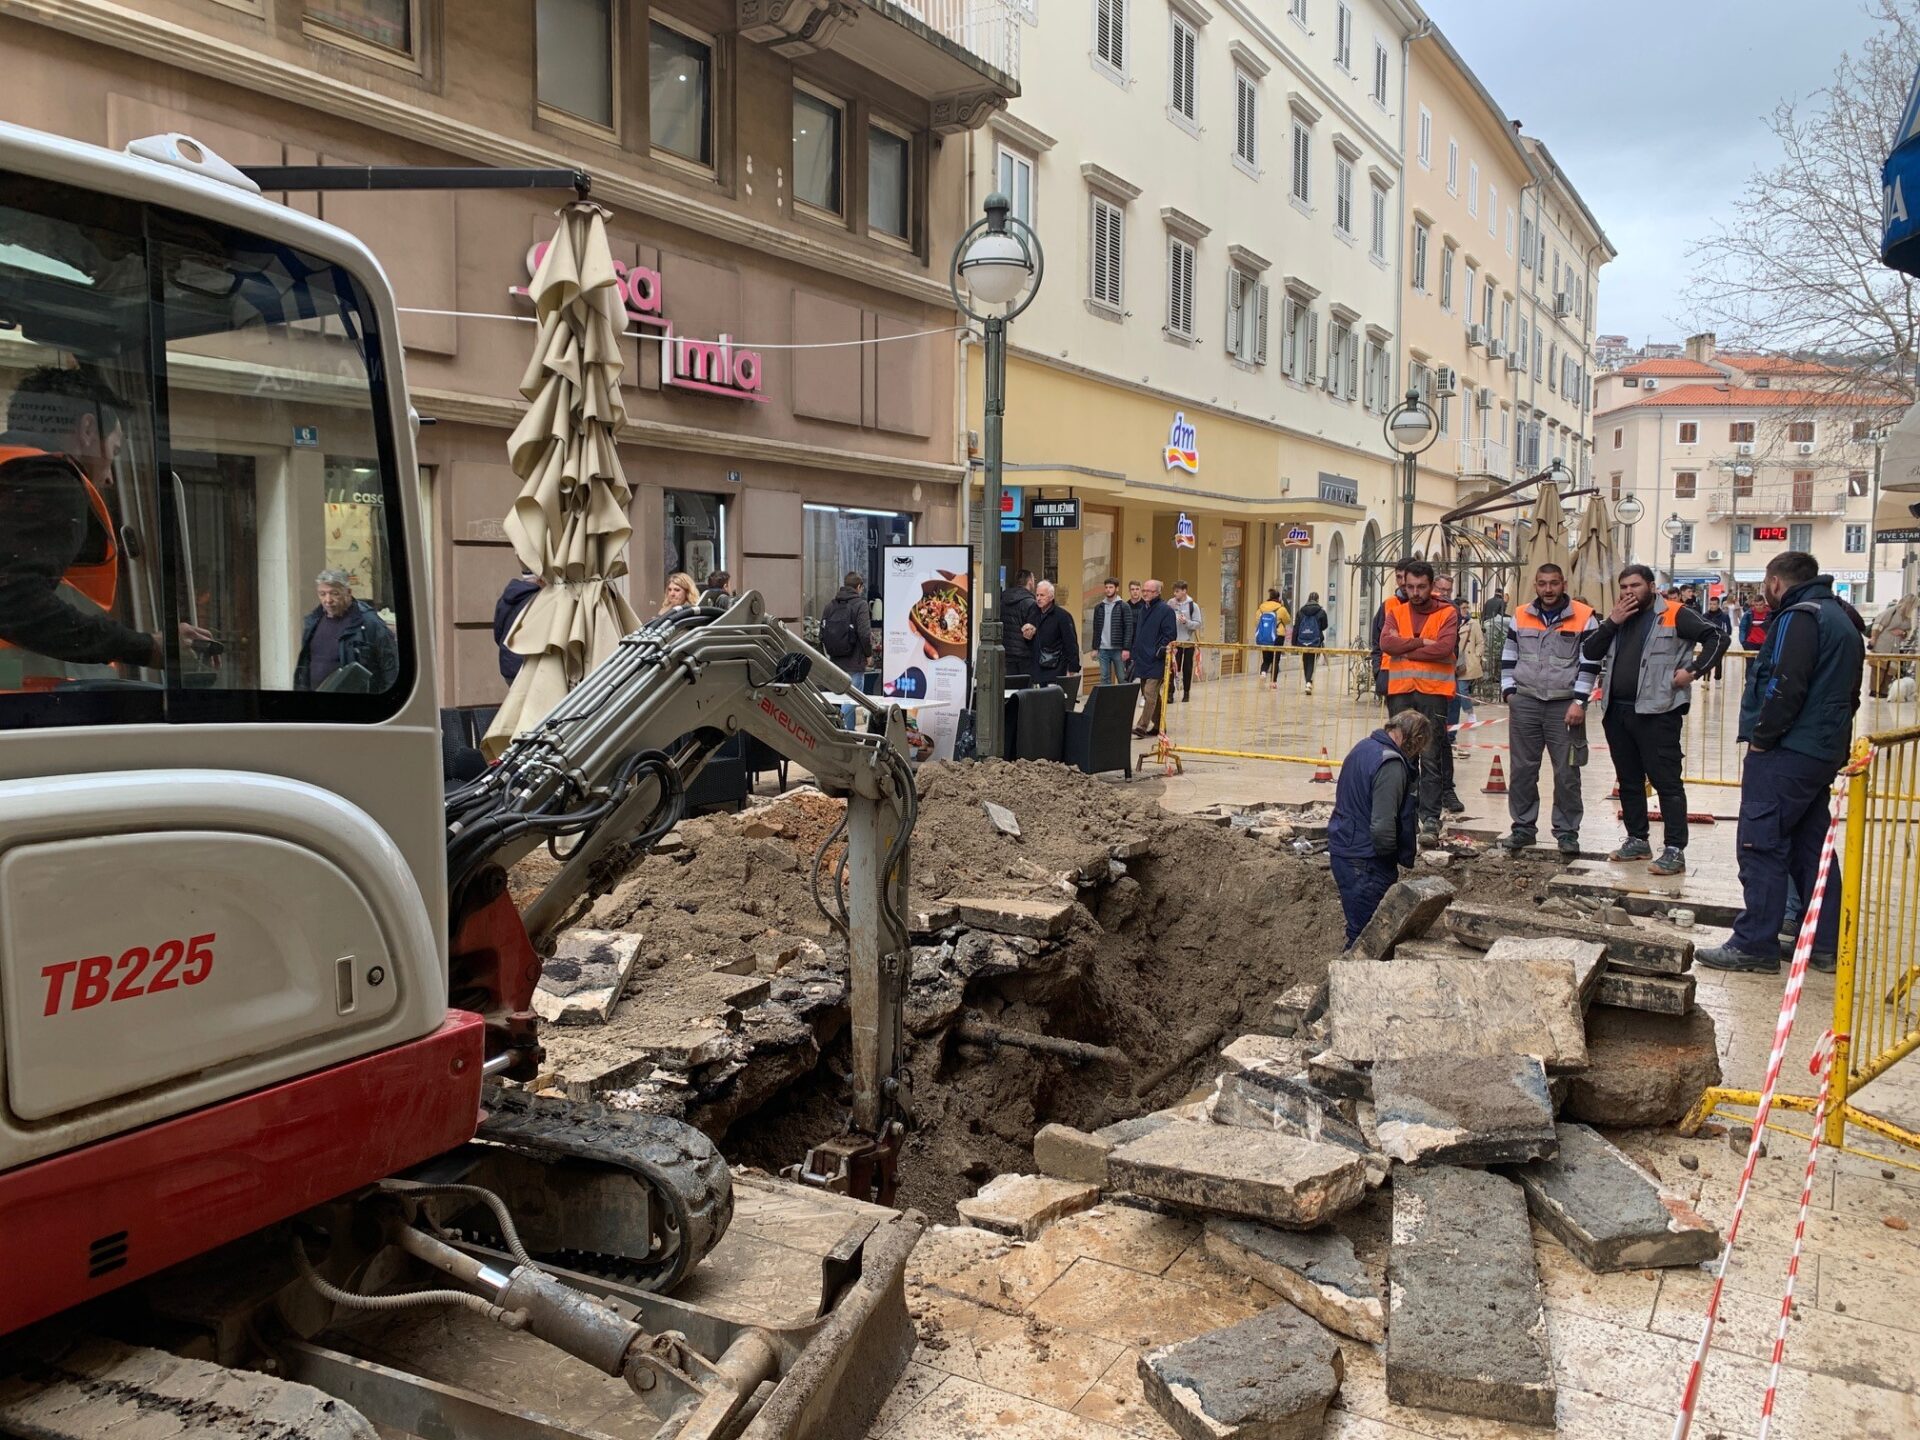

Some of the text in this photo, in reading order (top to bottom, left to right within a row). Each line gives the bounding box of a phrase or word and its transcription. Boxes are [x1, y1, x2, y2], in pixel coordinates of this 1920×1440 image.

[1173, 415, 1195, 450] dm
[1043, 516, 1065, 526] NOTAR
[1179, 514, 1193, 535] dm
[1289, 528, 1307, 539] dm
[758, 696, 816, 751] AKEUCHI
[41, 933, 216, 1017] TB225
